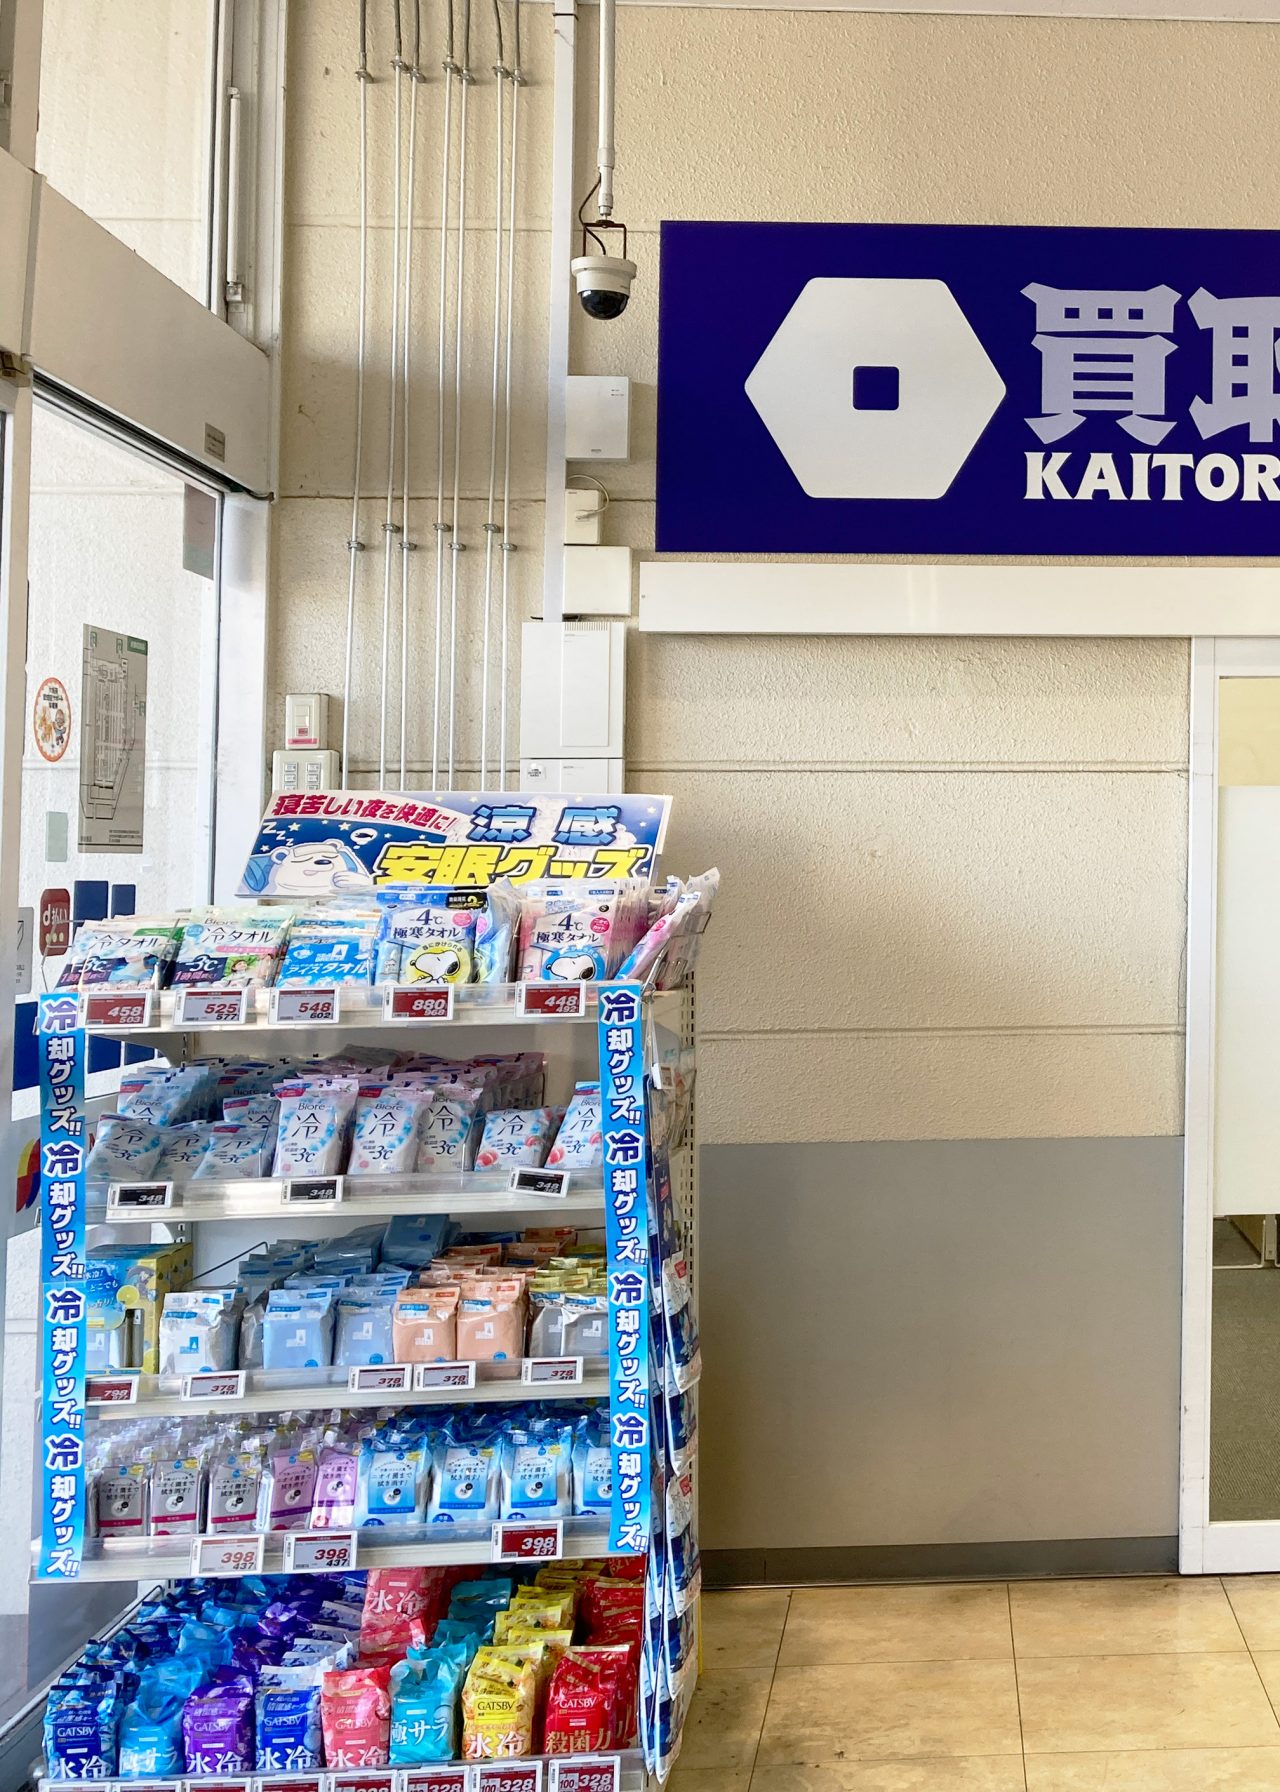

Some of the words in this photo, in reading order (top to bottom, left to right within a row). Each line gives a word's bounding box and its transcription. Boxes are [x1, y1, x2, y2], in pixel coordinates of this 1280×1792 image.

[272, 793, 458, 832] 寝苦しい夜を快適に!
[469, 804, 622, 845] 涼感
[376, 843, 650, 886] 安眠グッズ
[89, 933, 160, 950] 冷タオル
[202, 926, 276, 944] 冷タオル
[393, 926, 462, 940] 極寒タオル
[536, 929, 600, 945] 極寒タオル
[285, 960, 369, 976] アイスタオル
[204, 1003, 238, 1014] 525
[298, 1002, 332, 1013] 548
[412, 999, 446, 1010] 880
[544, 995, 578, 1006] 448
[108, 1006, 142, 1017] 458
[601, 990, 641, 1125] 冷却グッズ!!
[43, 1000, 82, 1136] 冷却グッズ!!
[291, 1112, 322, 1139] 冷
[368, 1111, 398, 1137] 冷
[427, 1105, 455, 1132] 冷
[497, 1114, 527, 1136] 冷
[572, 1108, 600, 1132] 冷
[114, 1127, 146, 1145] 冷
[605, 1129, 648, 1264] 冷却グッズ!!
[43, 1141, 86, 1279] 冷却グッズ!!
[610, 1271, 647, 1409] 冷却グッズ!!
[46, 1287, 82, 1429] 冷却グッズ!!
[612, 1412, 648, 1552] 冷却グッズ!!
[45, 1433, 81, 1577] 冷却グッズ!!
[522, 1537, 555, 1549] 398
[533, 1548, 555, 1556] 437
[221, 1552, 255, 1563] 398
[314, 1548, 349, 1560] 398
[326, 1558, 348, 1567] 437
[233, 1562, 254, 1571] 437
[368, 1589, 426, 1613] 氷冷
[477, 1700, 515, 1712] GATSBY
[559, 1697, 597, 1708] GATSBY
[193, 1721, 232, 1733] GATSBY
[264, 1715, 302, 1727] GATSBY
[57, 1726, 96, 1737] GATSBY
[390, 1717, 449, 1745] 極サラ
[467, 1731, 526, 1757] 氷冷
[546, 1729, 612, 1753] 殺菌力
[51, 1755, 107, 1778] 氷冷
[186, 1751, 244, 1774] 氷冷
[256, 1746, 313, 1770] 氷冷
[499, 1778, 534, 1791] 328
[578, 1773, 613, 1787] 328
